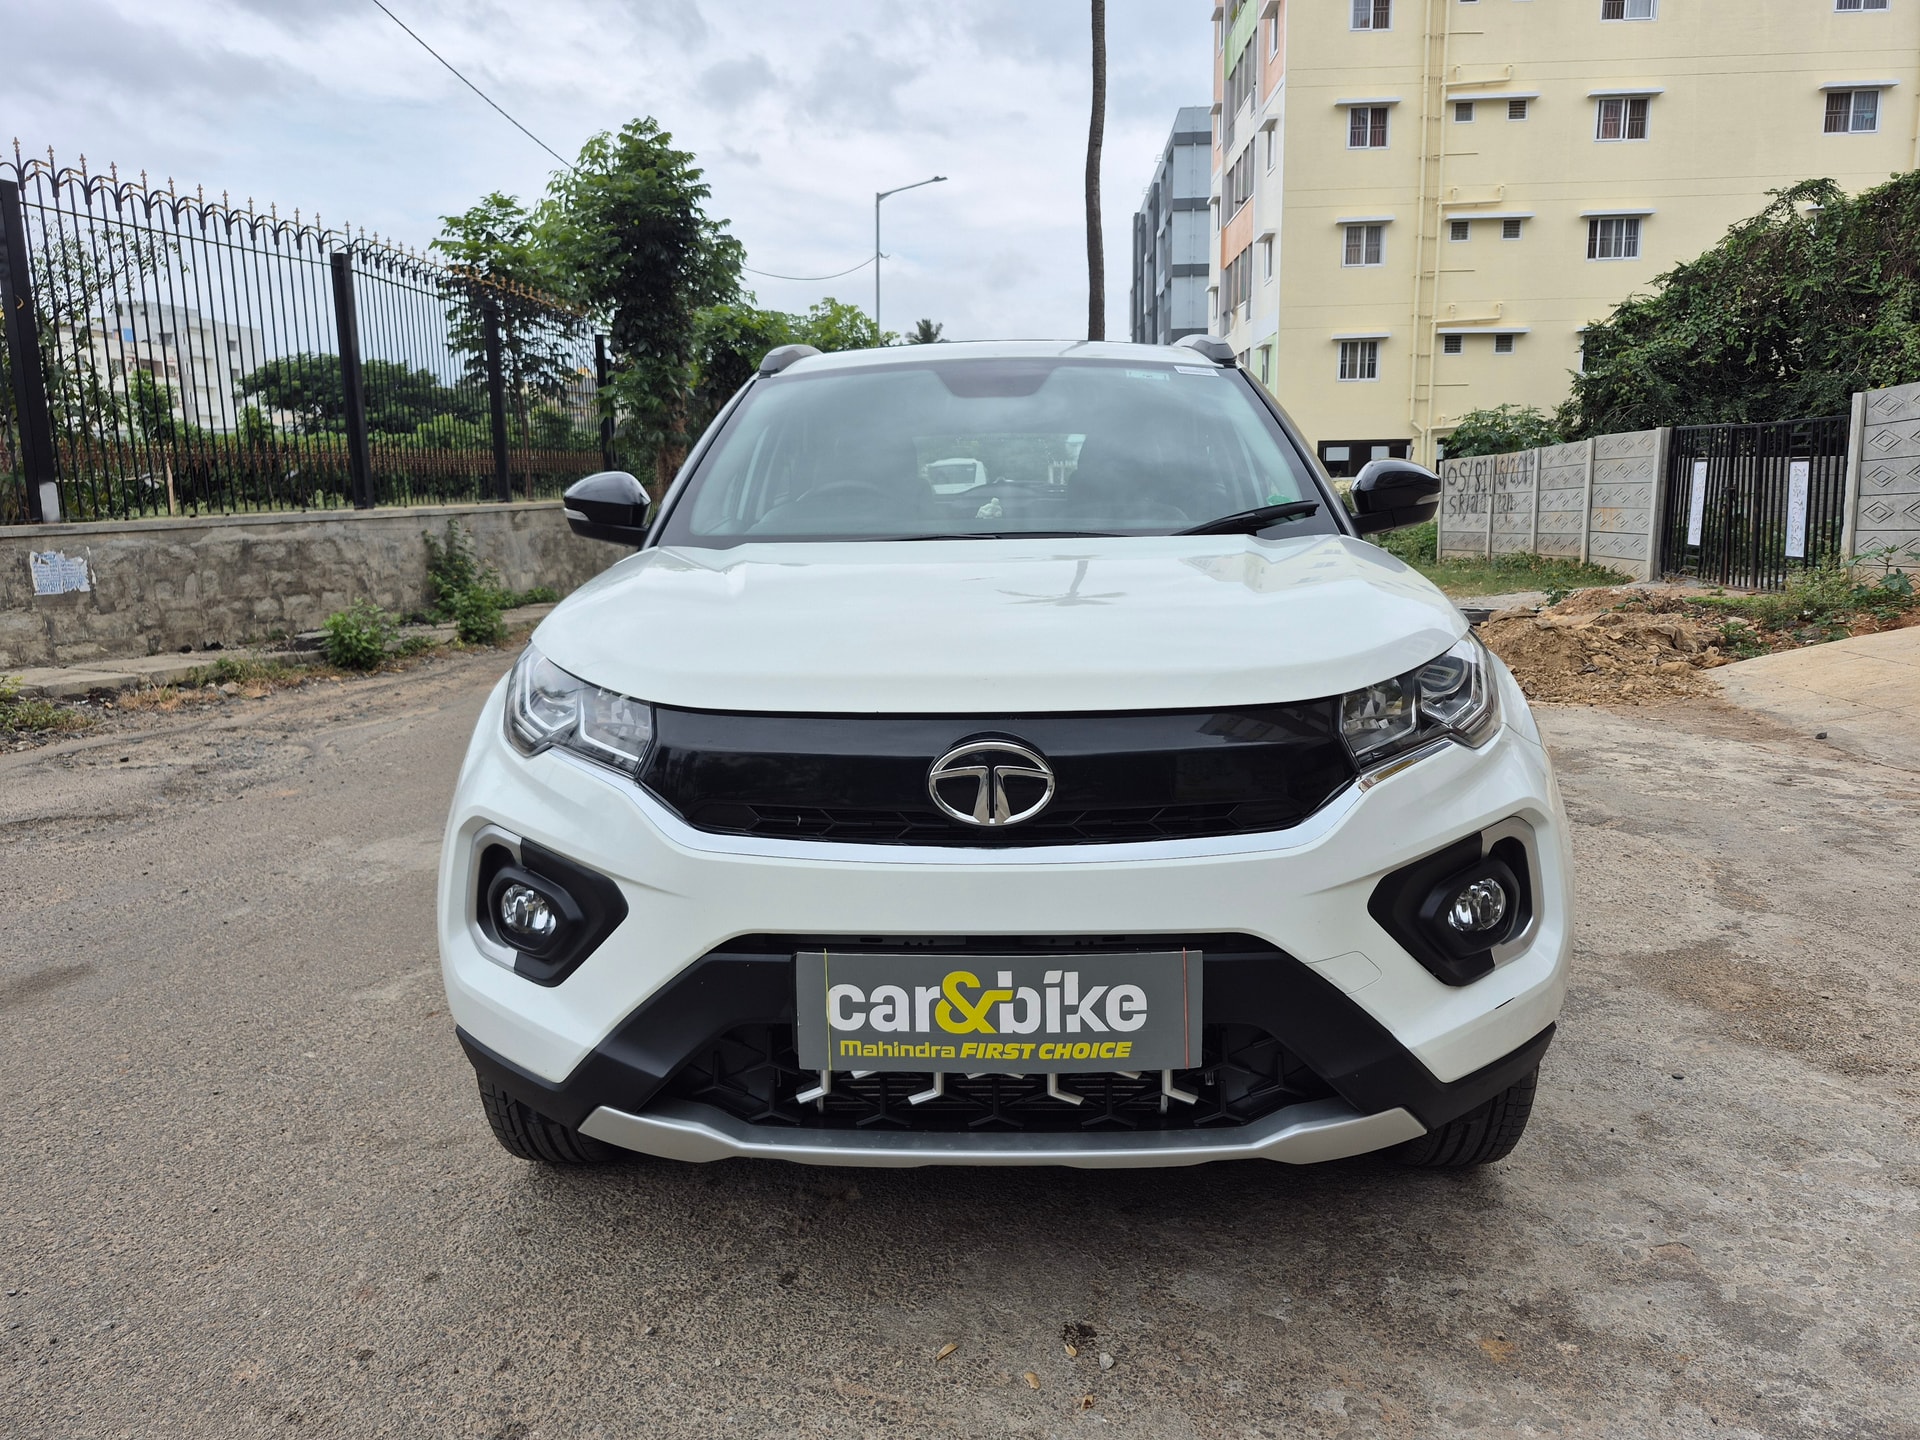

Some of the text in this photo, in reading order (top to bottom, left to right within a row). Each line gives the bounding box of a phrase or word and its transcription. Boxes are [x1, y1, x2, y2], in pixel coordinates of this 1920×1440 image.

[828, 970, 1148, 1034] car&bike
[840, 1040, 1133, 1060] Mahindra FIRST CHOICE
